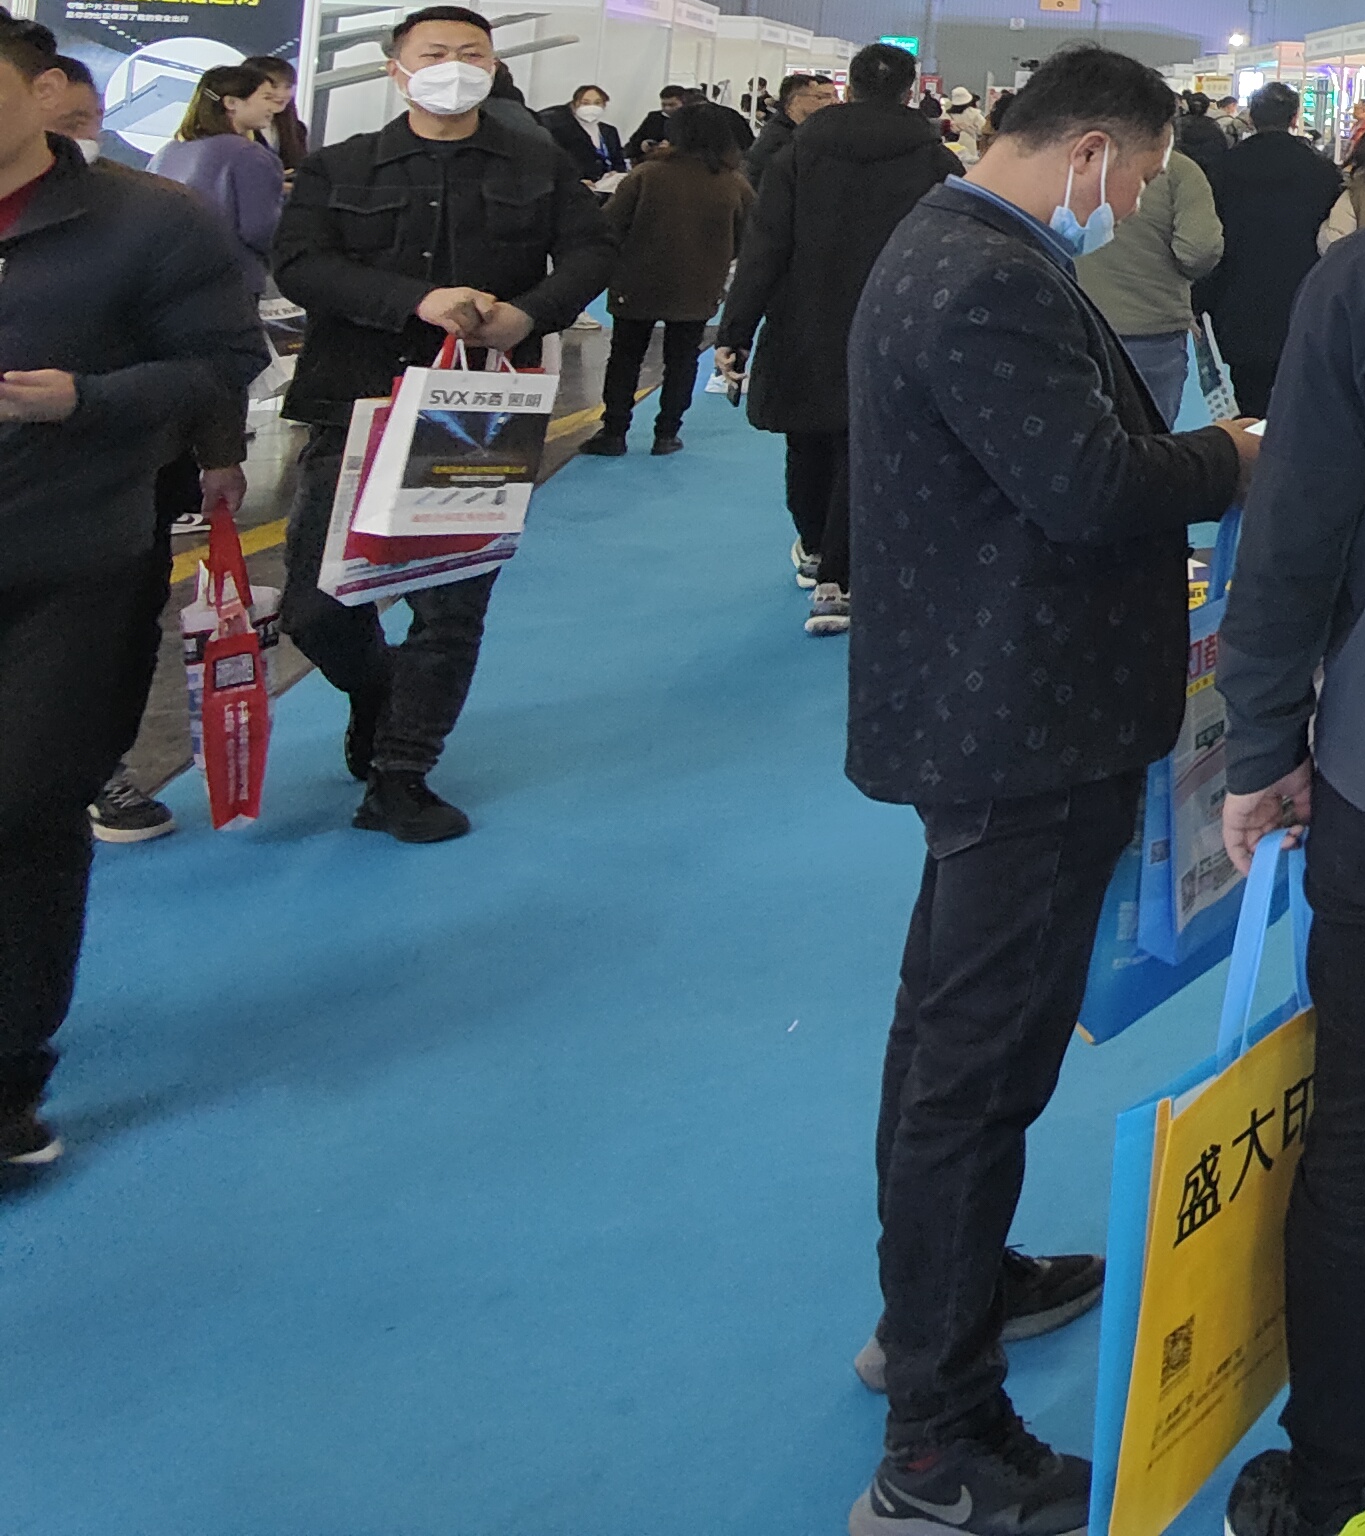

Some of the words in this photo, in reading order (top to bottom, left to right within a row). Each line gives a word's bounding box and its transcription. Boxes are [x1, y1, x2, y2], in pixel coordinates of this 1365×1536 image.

[429, 389, 470, 406] SVX
[1172, 1072, 1317, 1250] 盛大印
